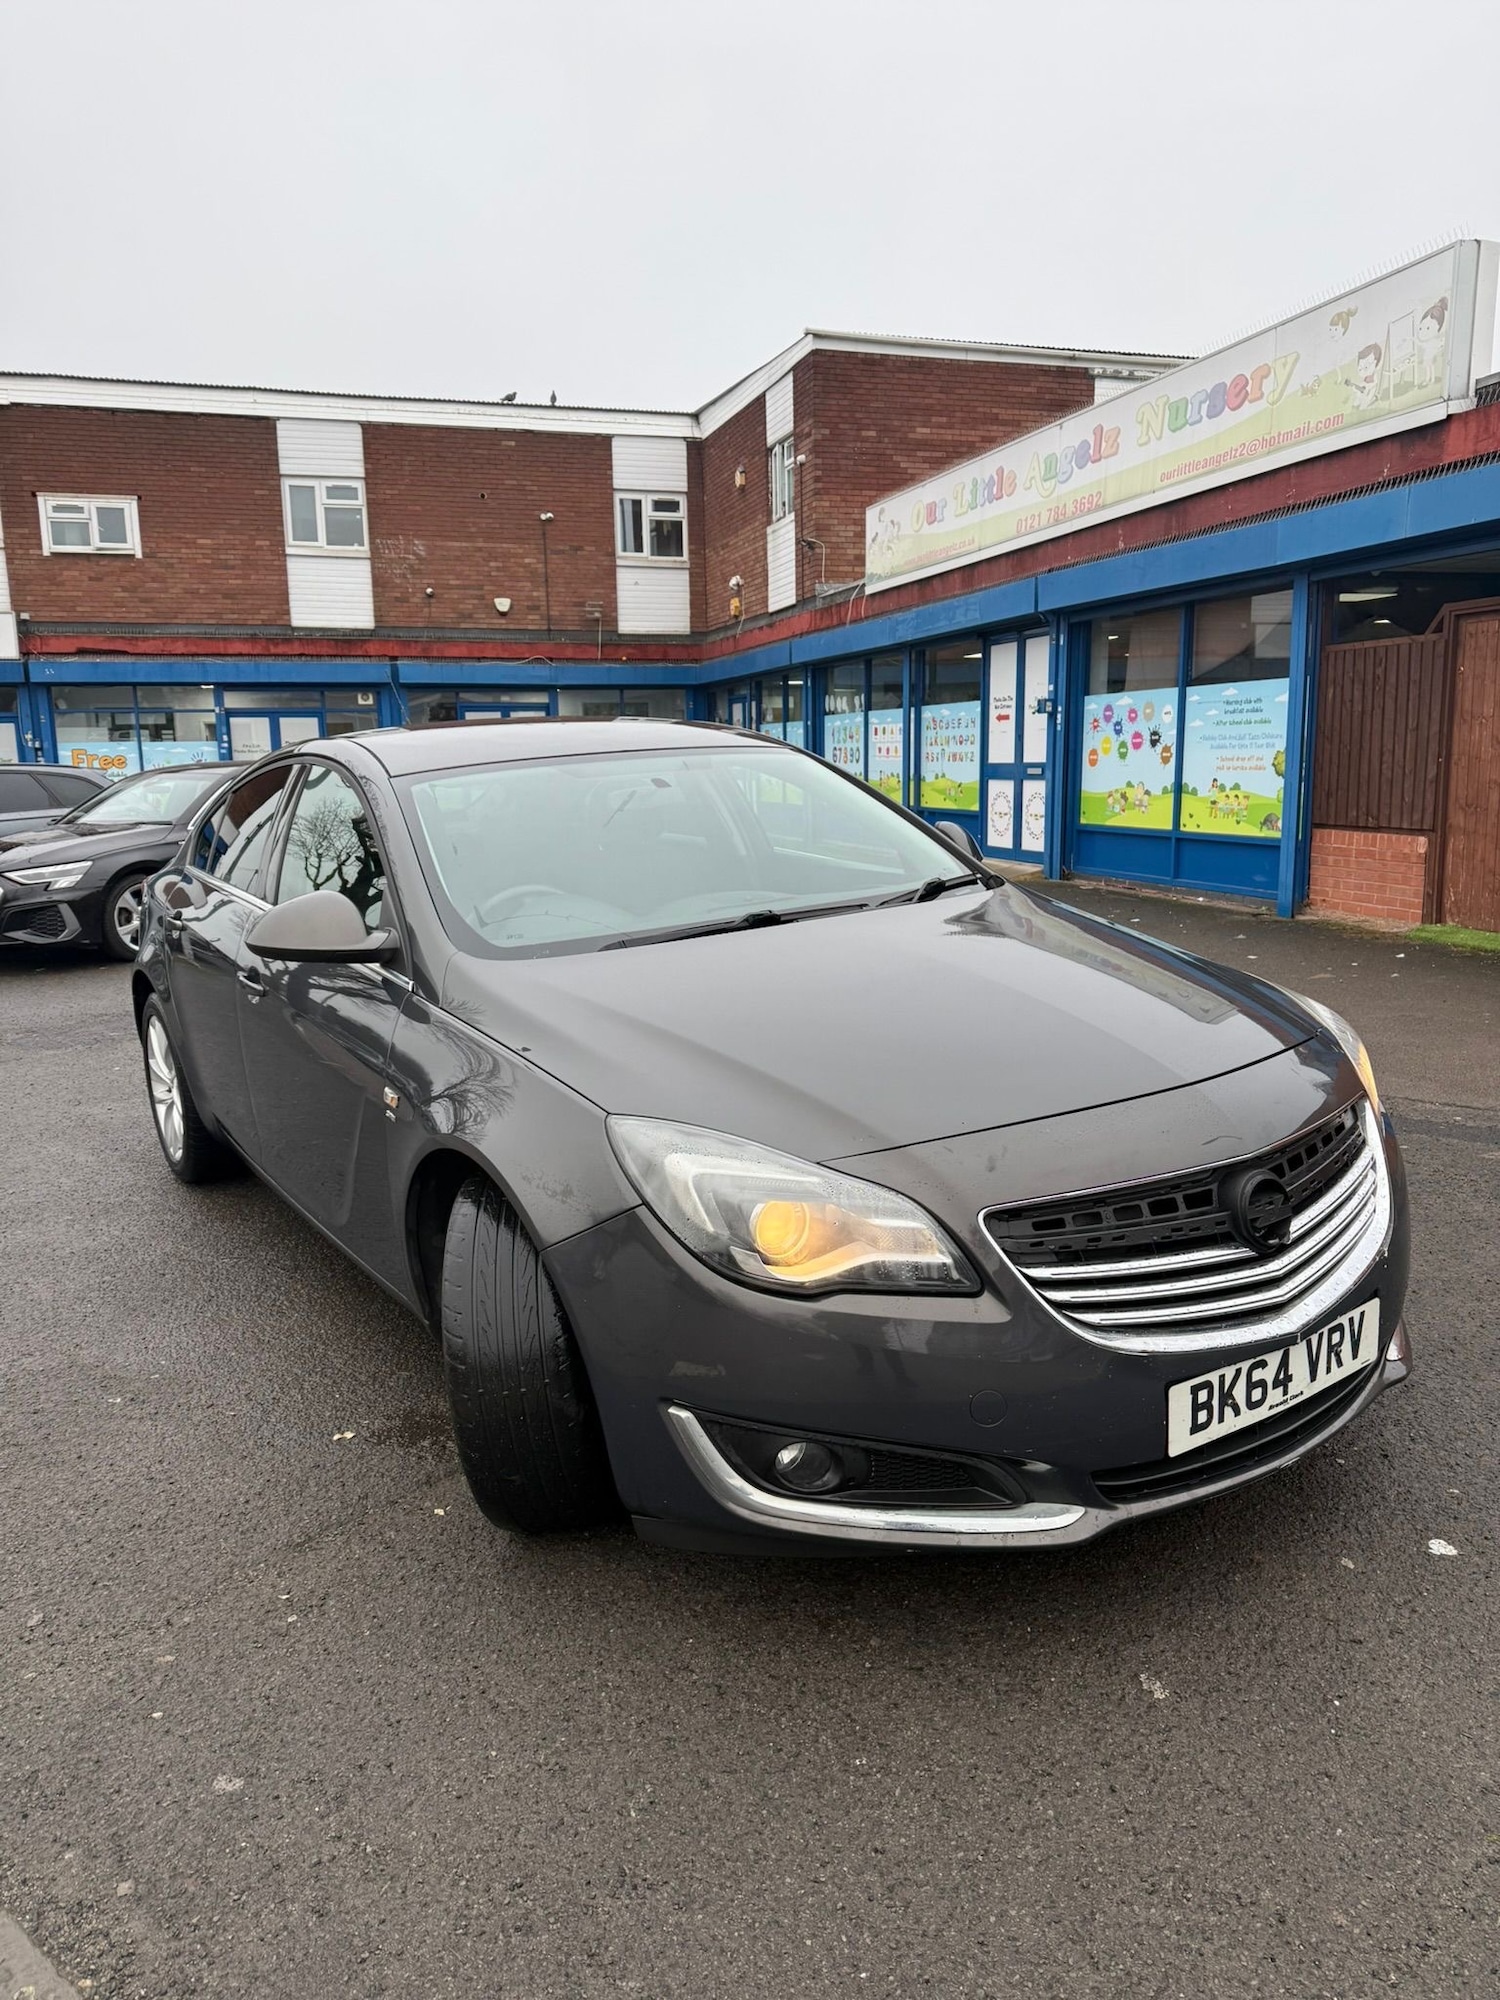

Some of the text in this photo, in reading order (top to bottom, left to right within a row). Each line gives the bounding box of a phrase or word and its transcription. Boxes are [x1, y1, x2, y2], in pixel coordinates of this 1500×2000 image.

[910, 351, 1301, 533] Our Little Angelz Nursery
[1159, 411, 1345, 483] ourlittleangelz2@hotmail.com
[1015, 490, 1103, 535] 0121 784 3692
[71, 747, 128, 770] Free
[1189, 1310, 1366, 1436] BK64 VRV
[1289, 1390, 1304, 1401] Clark
